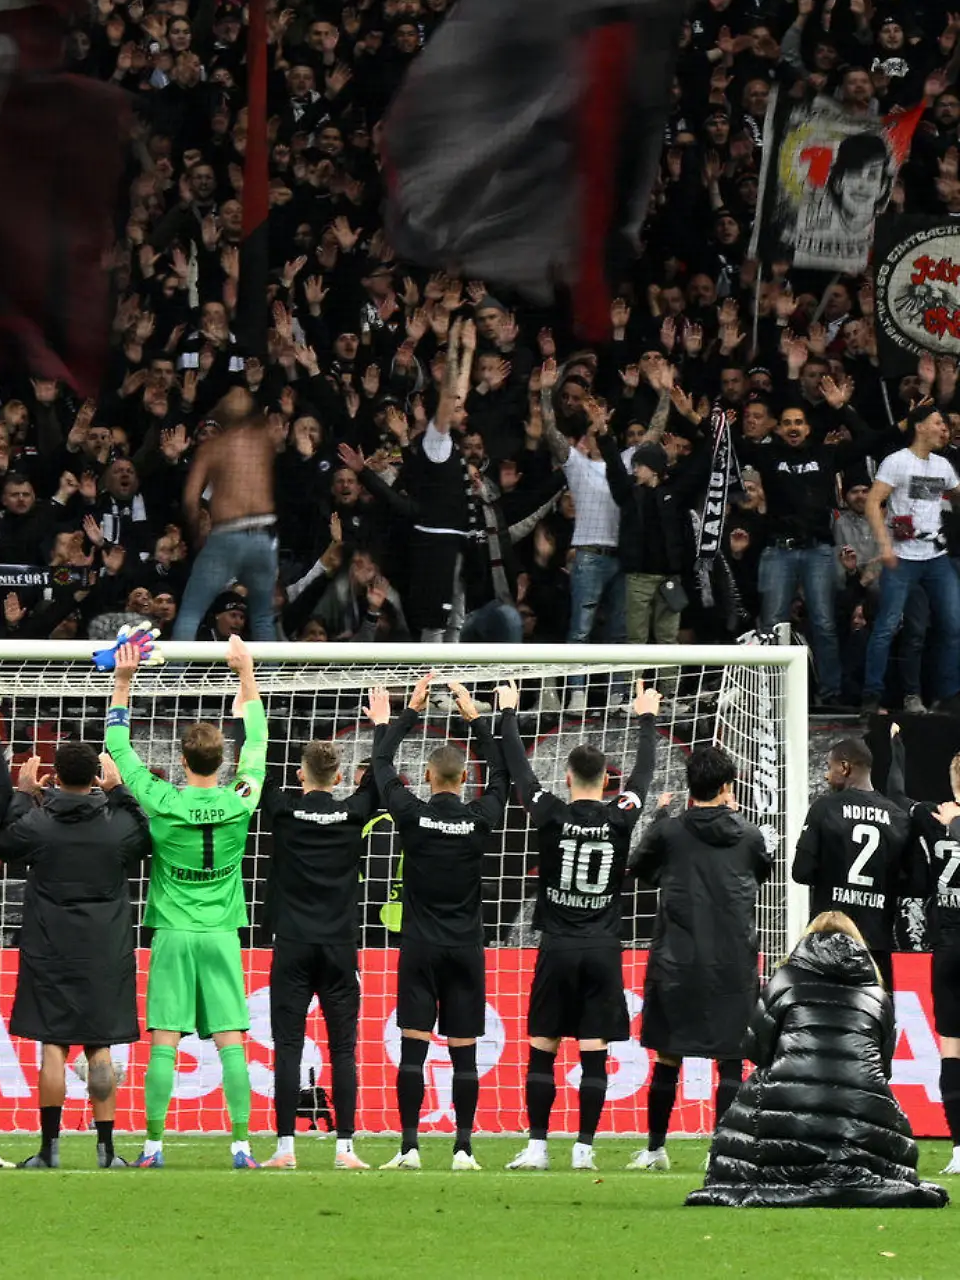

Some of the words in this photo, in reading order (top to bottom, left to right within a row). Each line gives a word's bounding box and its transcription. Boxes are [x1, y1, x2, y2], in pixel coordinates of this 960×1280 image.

[701, 471, 725, 552] LAZIO
[189, 807, 226, 823] TRAPP
[842, 804, 891, 825] NDICKA
[196, 823, 214, 870] 1
[559, 839, 615, 894] 10
[847, 823, 881, 887] 2
